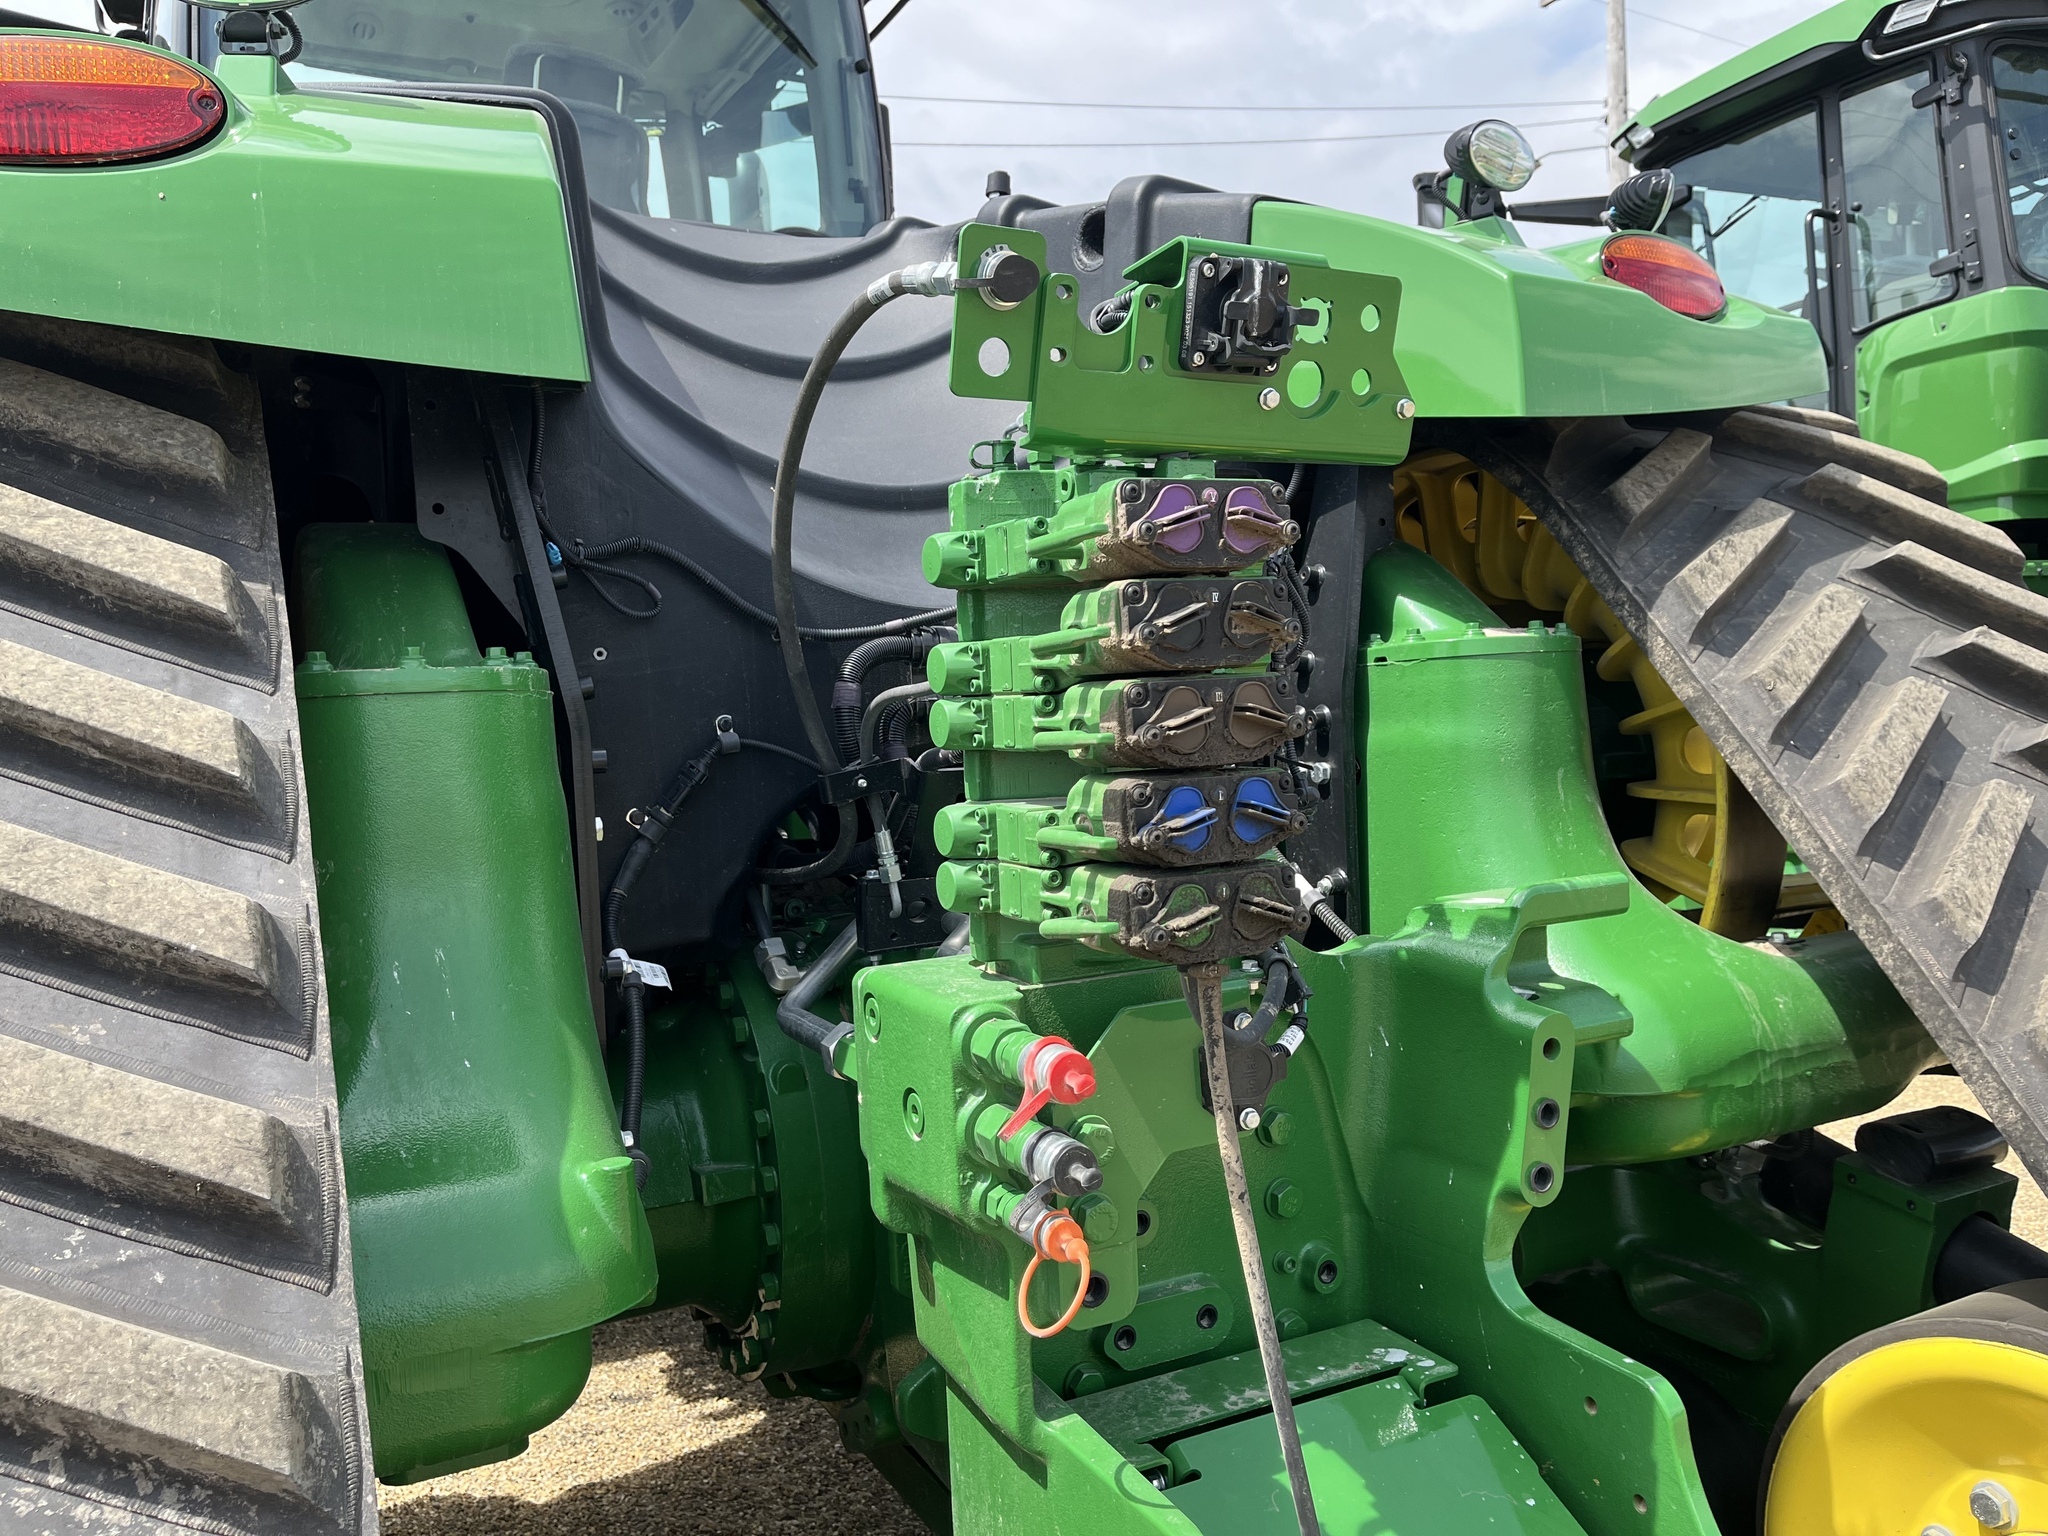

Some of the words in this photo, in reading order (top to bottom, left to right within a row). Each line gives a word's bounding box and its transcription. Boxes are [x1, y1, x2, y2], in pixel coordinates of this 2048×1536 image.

[1209, 491, 1217, 503] V
[1212, 592, 1219, 602] IV
[1244, 1054, 1257, 1094] Pollak
